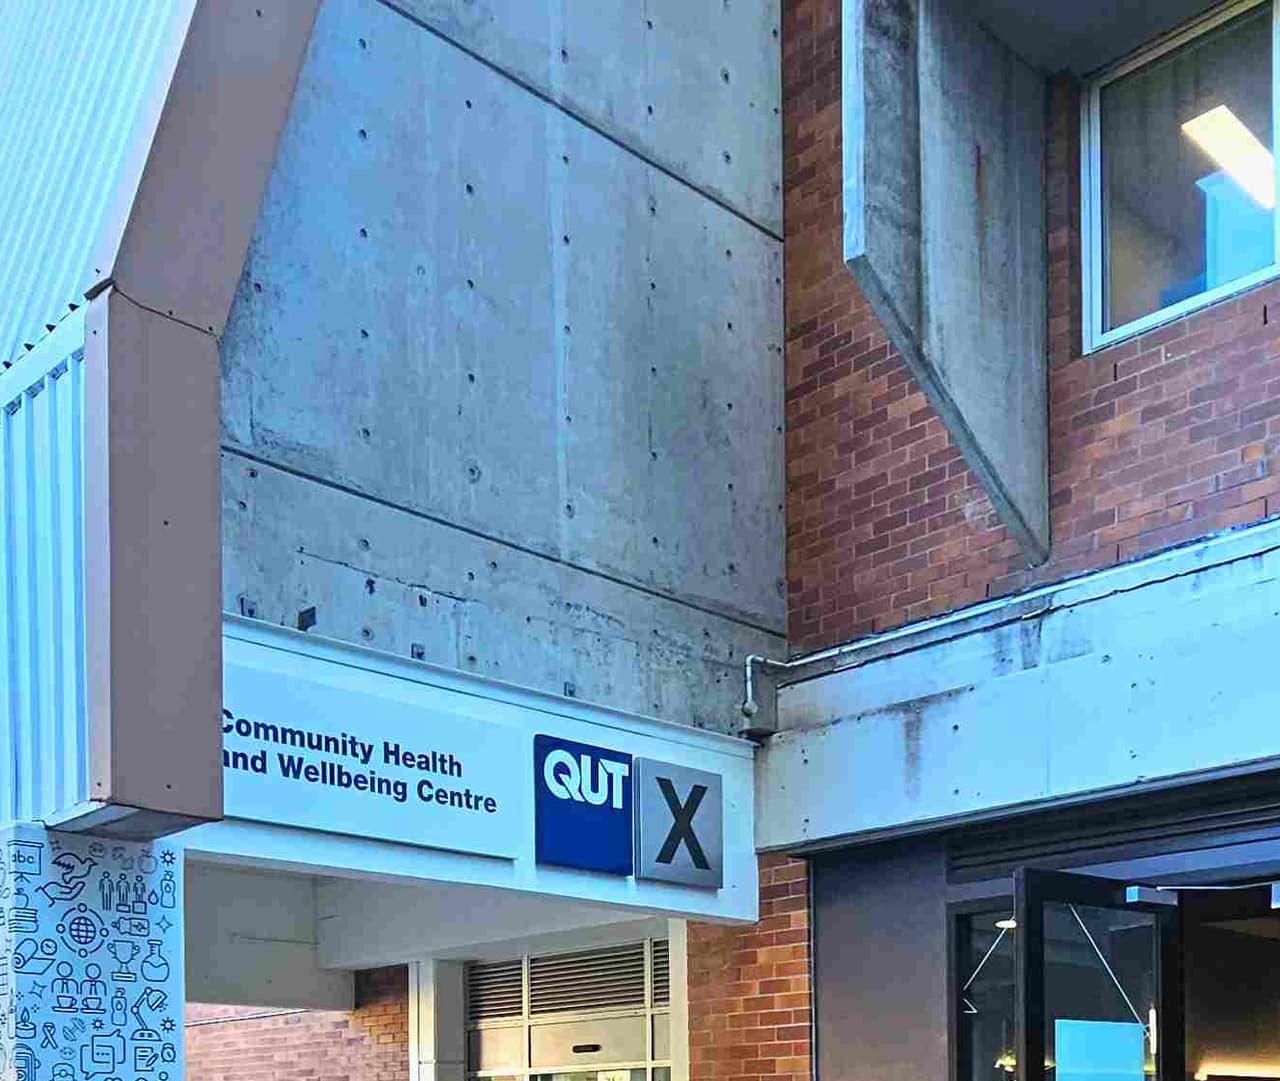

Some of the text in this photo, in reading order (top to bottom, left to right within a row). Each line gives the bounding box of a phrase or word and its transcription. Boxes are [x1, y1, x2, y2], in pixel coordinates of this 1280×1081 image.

[222, 709, 463, 778] Community Health
[276, 753, 408, 802] Wellbeing
[416, 780, 498, 813] Centre
[544, 749, 629, 809] QUT
[655, 776, 711, 870] X
[11, 849, 34, 865] abc
